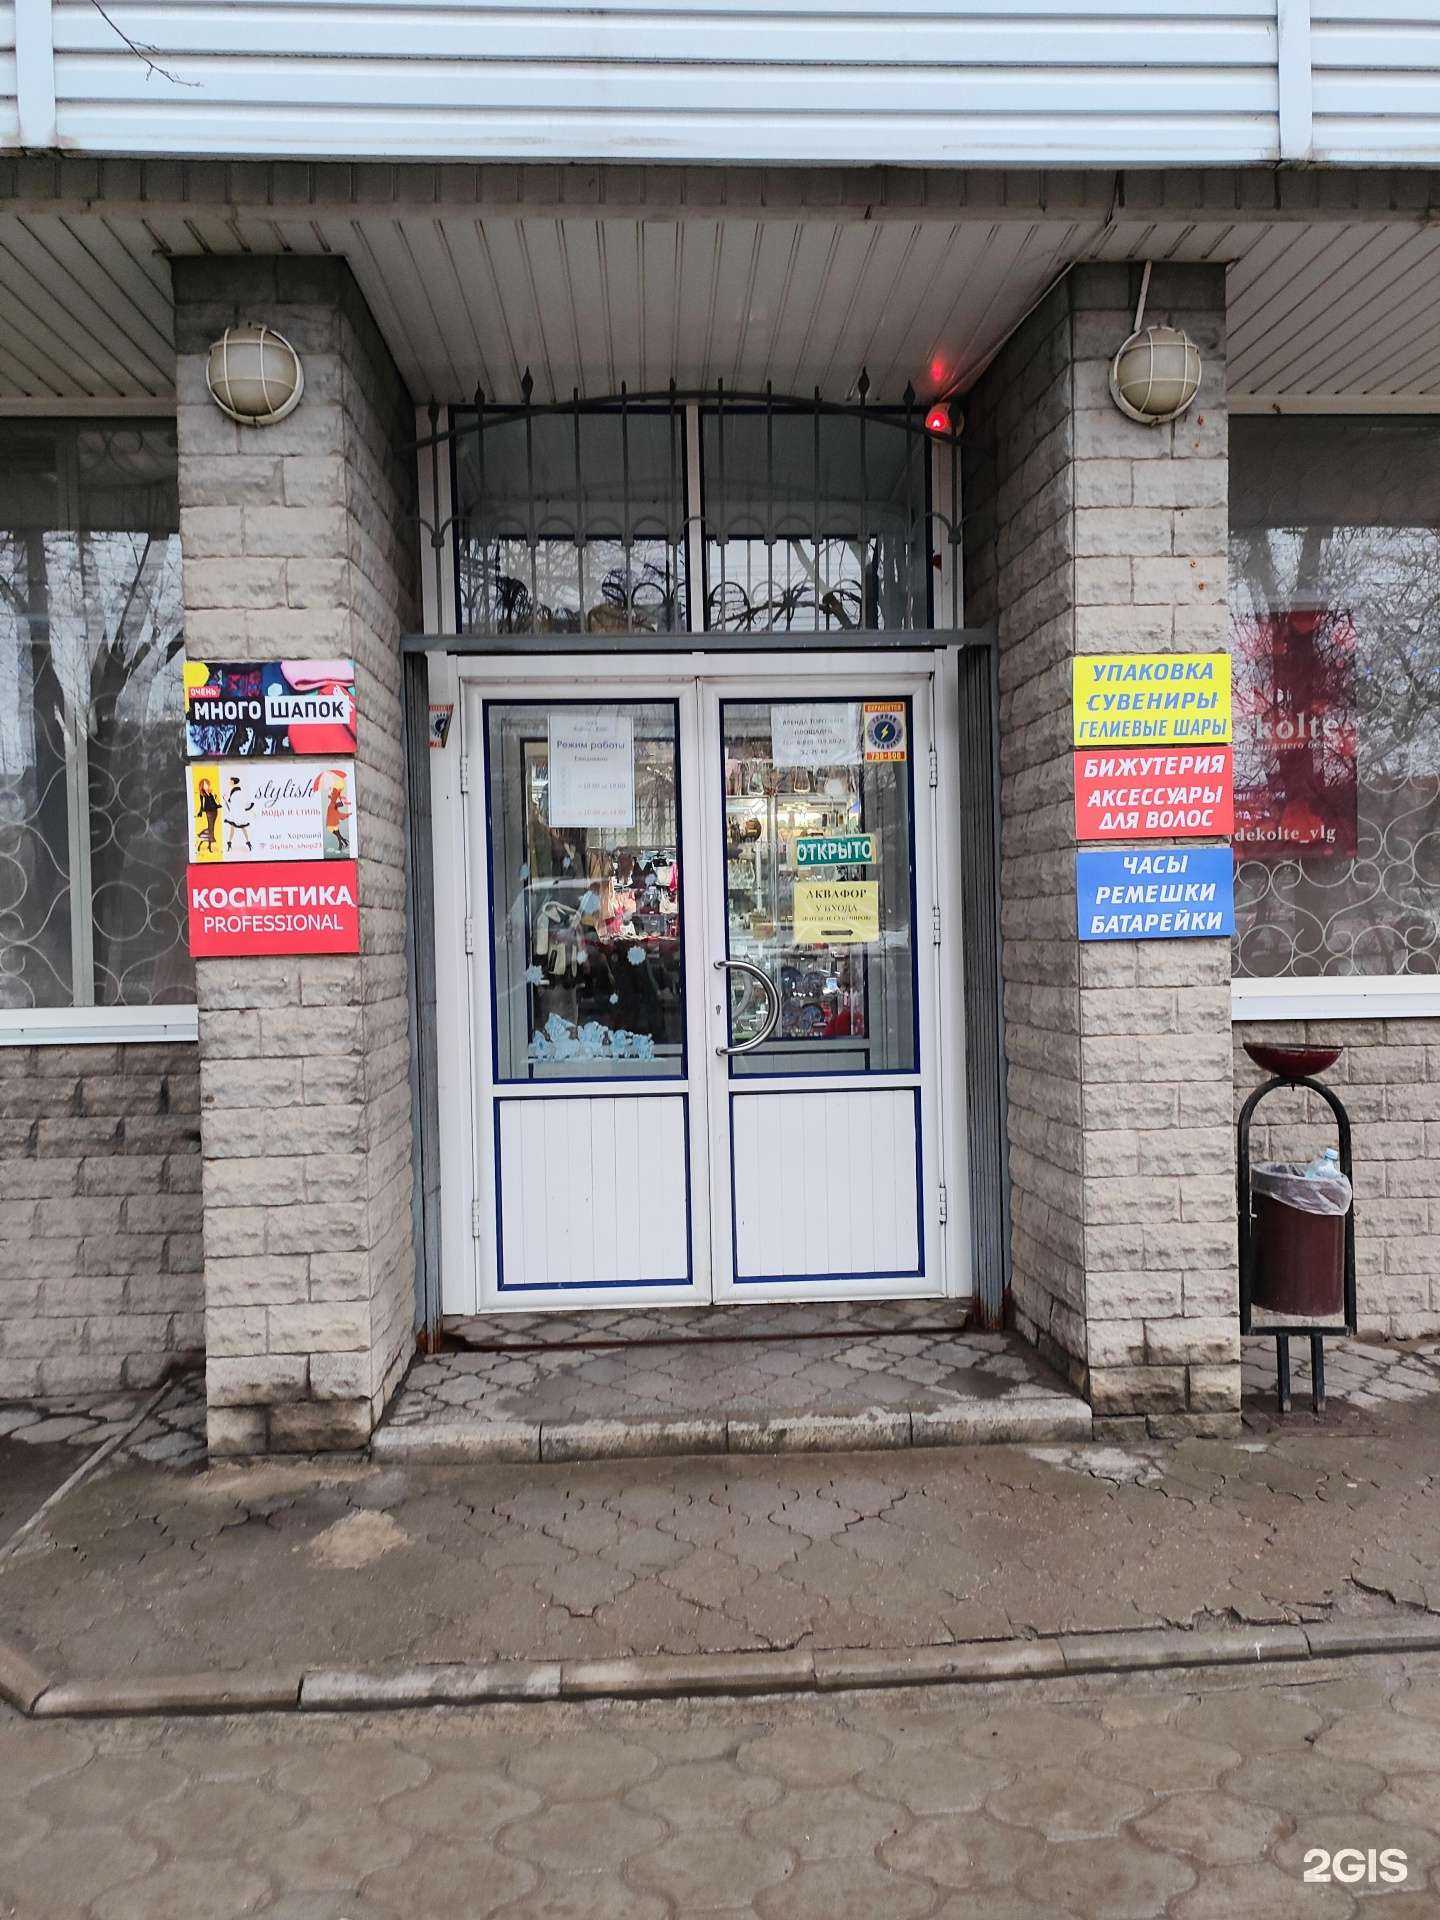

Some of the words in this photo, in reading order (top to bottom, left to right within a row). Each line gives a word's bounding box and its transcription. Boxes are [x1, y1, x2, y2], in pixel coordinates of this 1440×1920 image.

[1093, 662, 1214, 682] УПАКОВКА
[190, 687, 217, 697] ОЧЕНЬ
[1086, 692, 1219, 712] СУВЕНИРЫ
[194, 700, 262, 721] МНОГО
[270, 700, 346, 719] ШАПОК
[1079, 719, 1167, 739] ГЕЛИЕВЫЕ
[1173, 718, 1227, 737] ШАРЫ
[1236, 712, 1340, 740] ekolte
[556, 740, 588, 749] Режим
[590, 740, 625, 751] работы
[1084, 755, 1225, 778] БИЖУТЕРИЯ
[254, 778, 314, 809] stylish
[1087, 785, 1223, 807] АКСЕССУАРЫ
[1099, 811, 1138, 830] ДЛЯ
[1146, 809, 1214, 829] ВОЛОС
[1234, 823, 1337, 844] dekolte_vlg
[797, 842, 872, 862] ОТКРЫТО
[1123, 855, 1189, 875] ЧАСЫ
[192, 885, 356, 909] КОСМЕТИКА
[806, 888, 867, 899] АКВАФОР
[1096, 883, 1217, 905] РЕМЕШКИ
[204, 914, 344, 933] PROFESSIONAL
[1090, 909, 1223, 934] БАТАРЕЙКИ
